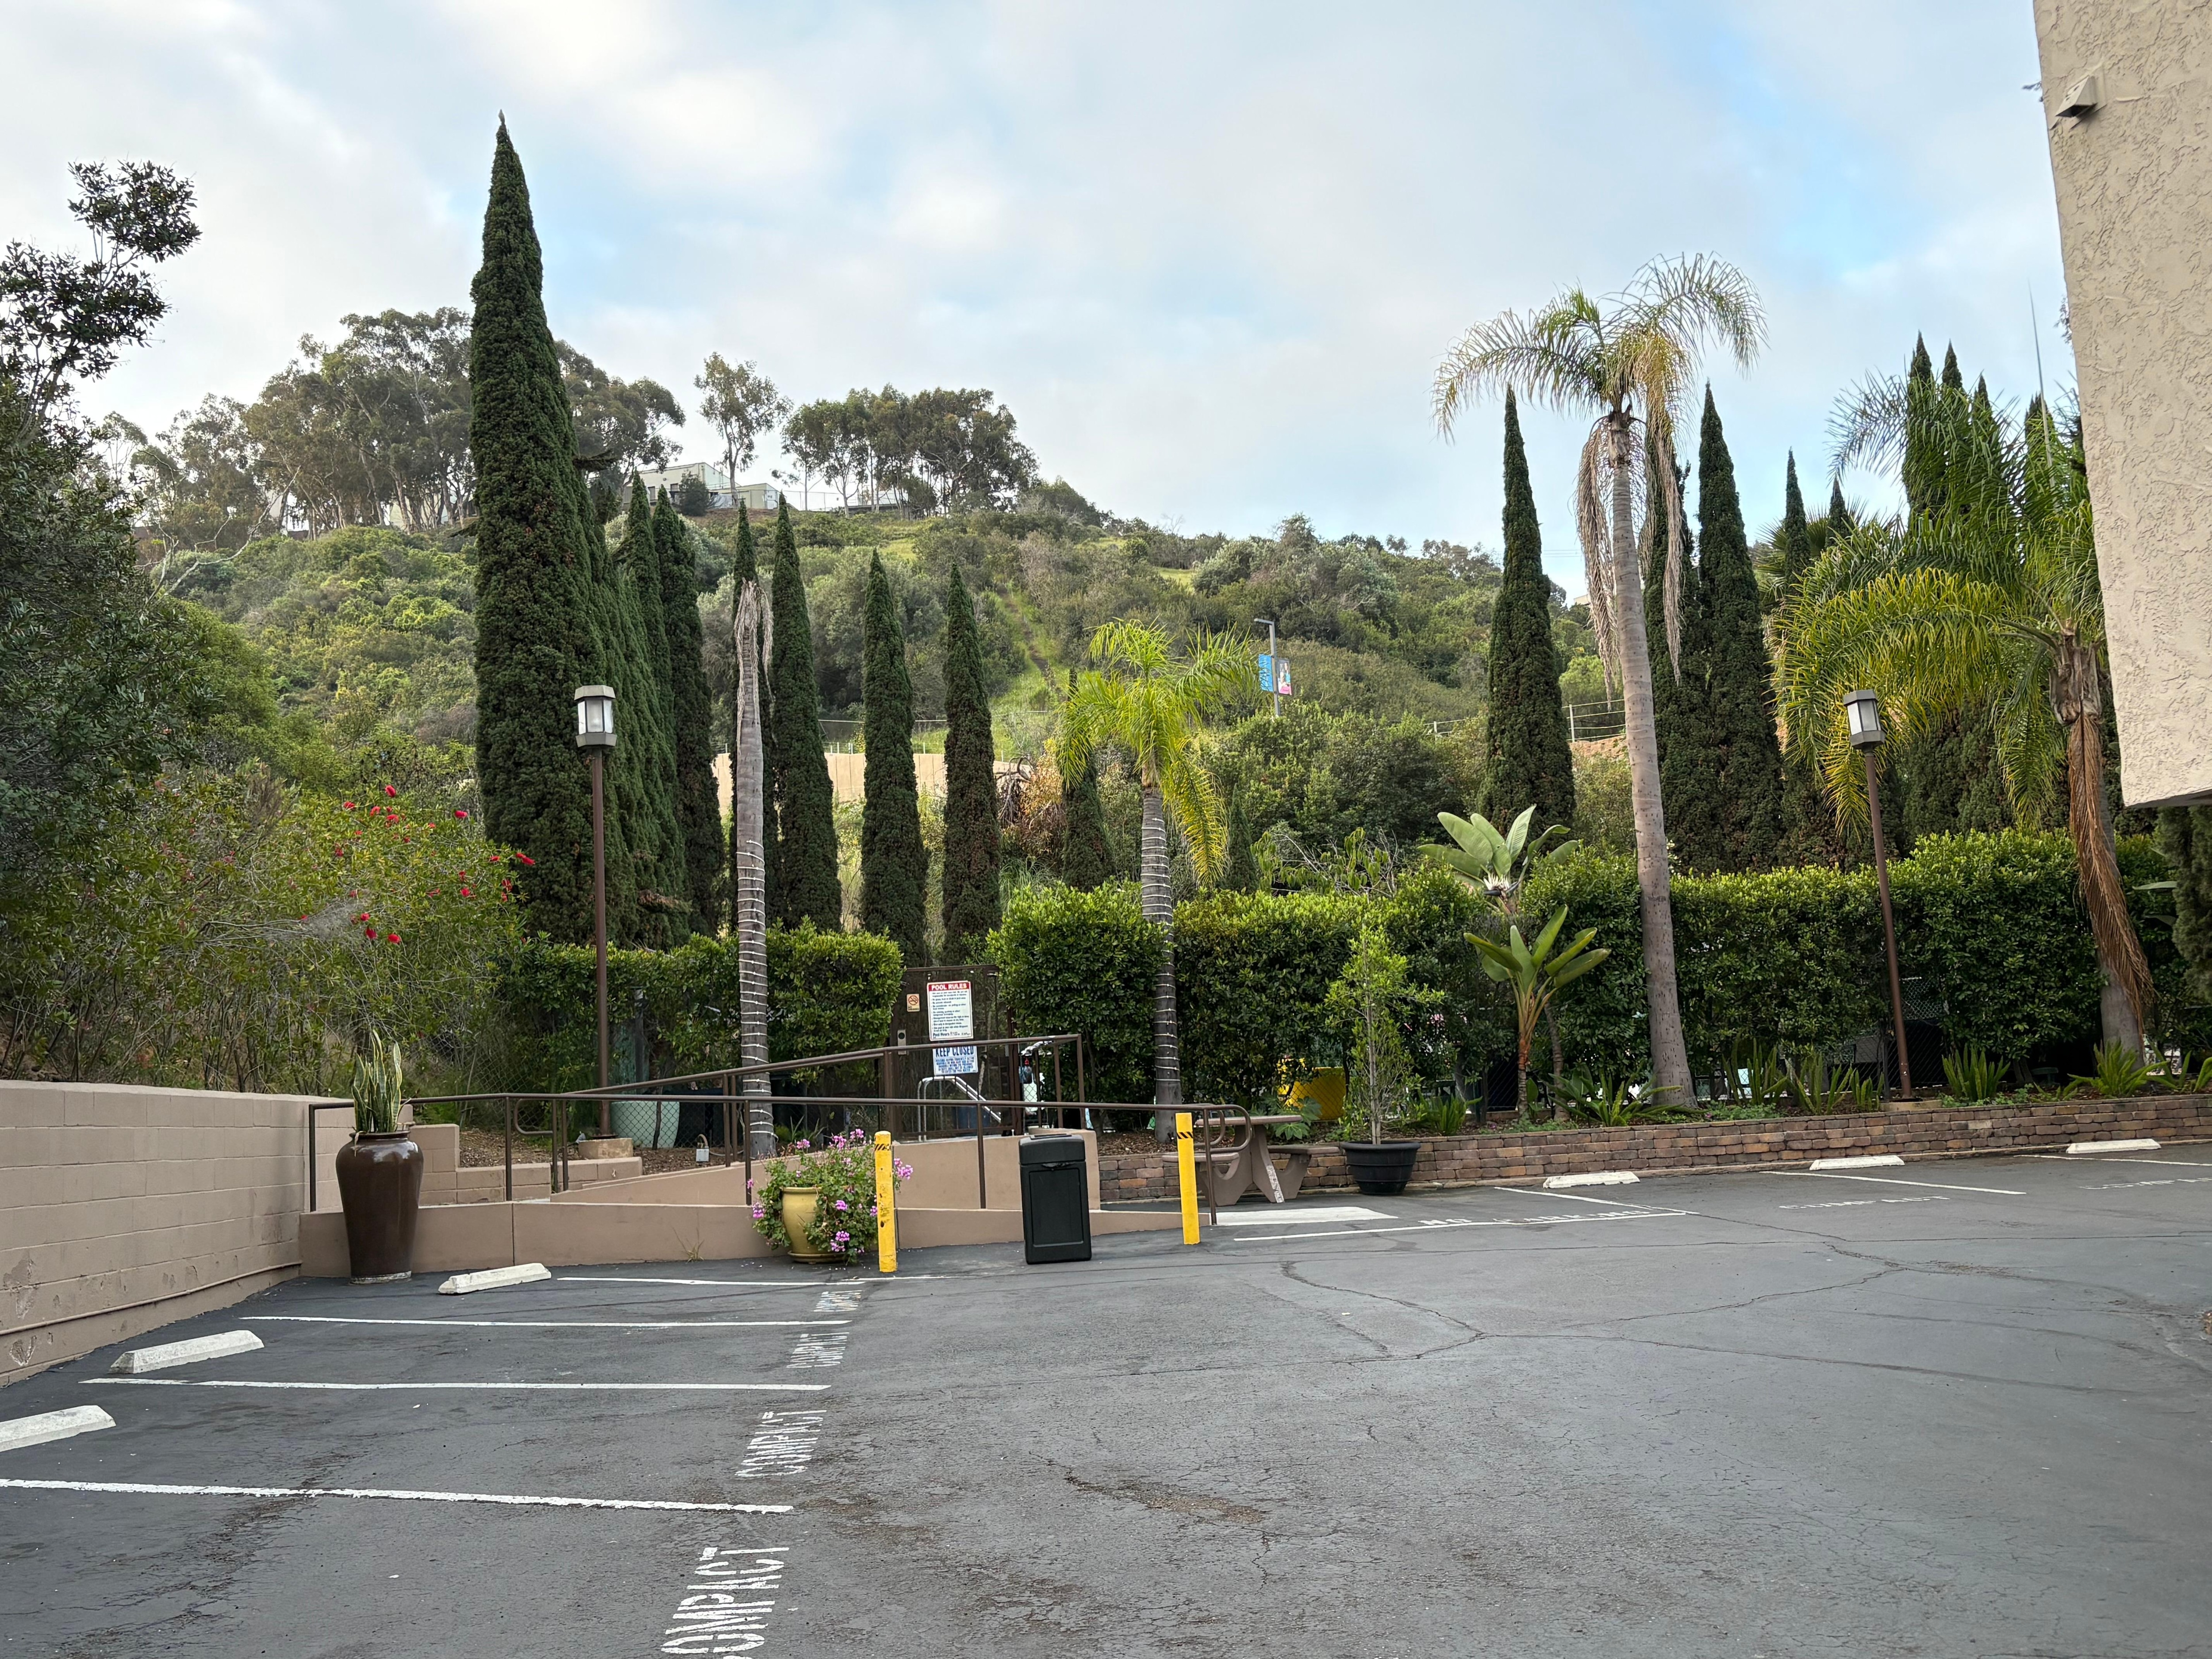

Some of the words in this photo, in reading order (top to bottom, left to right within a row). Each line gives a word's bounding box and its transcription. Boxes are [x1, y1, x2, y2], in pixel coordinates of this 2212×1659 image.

[936, 1047, 950, 1057] KEEP
[952, 1046, 974, 1056] CLOSED
[1778, 1196, 1950, 1209] COMPACT
[786, 1333, 850, 1368] COMPACT
[734, 1410, 827, 1477] COMPACT
[660, 1547, 790, 1659] OMPACT
